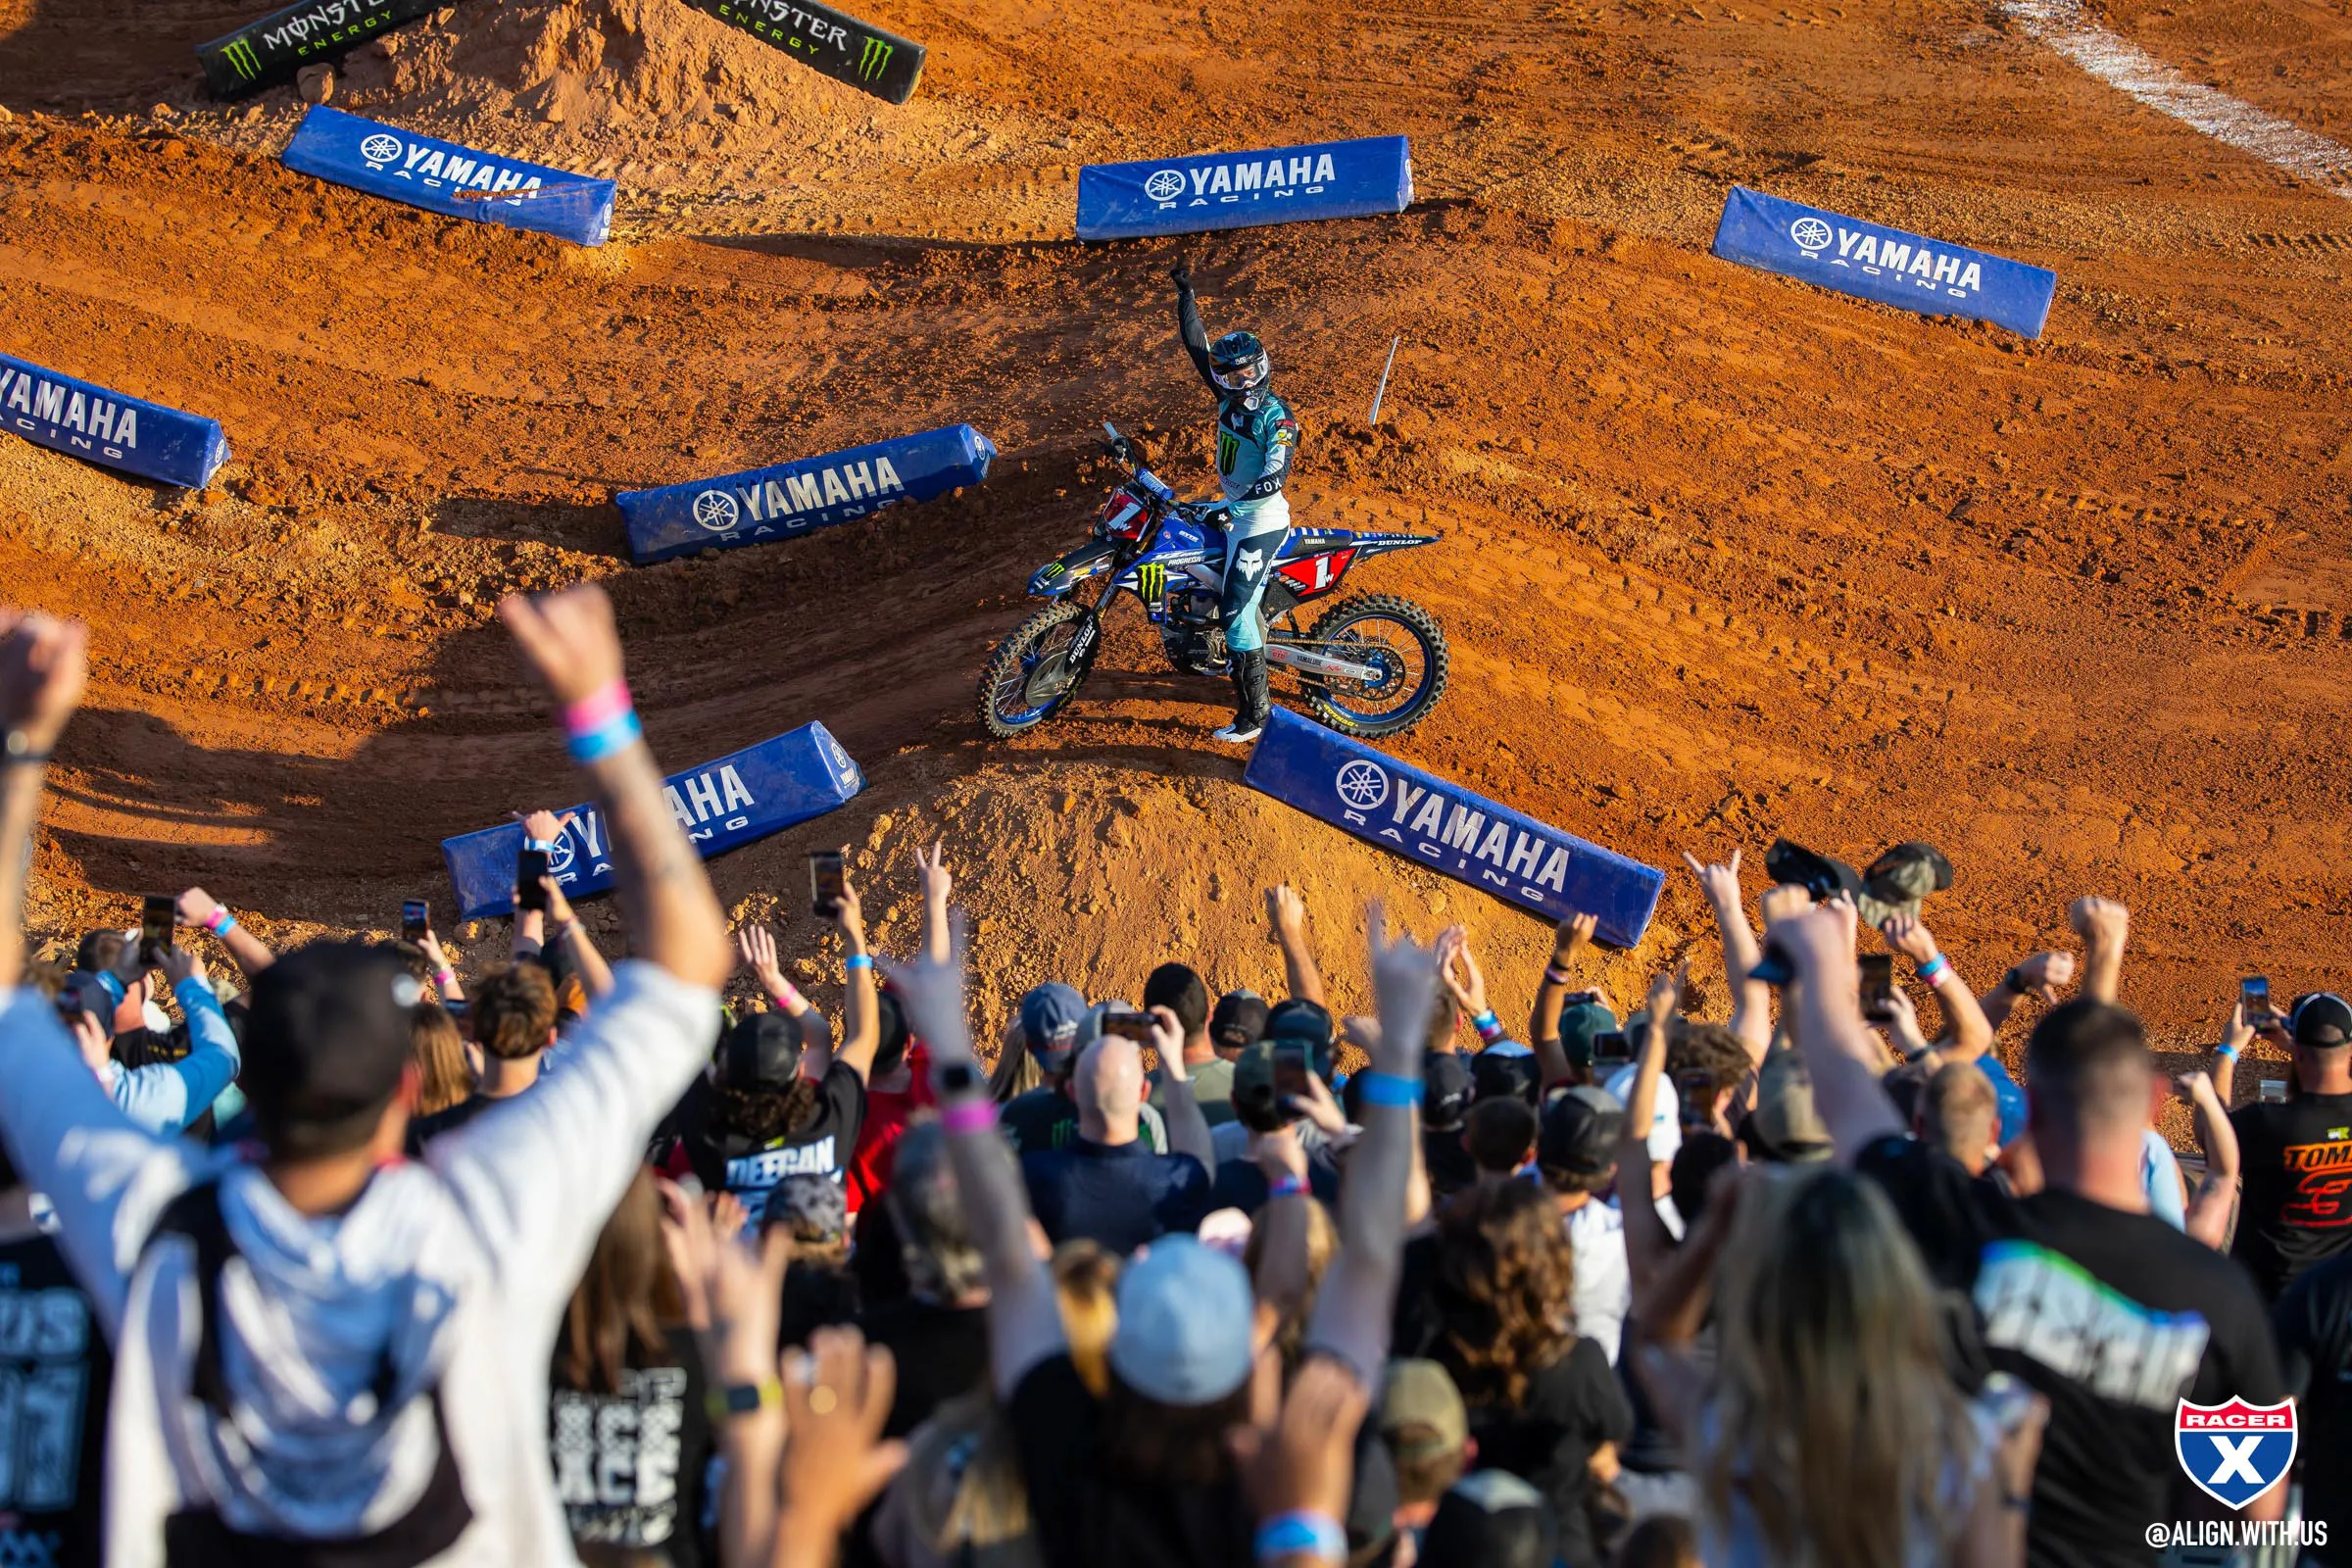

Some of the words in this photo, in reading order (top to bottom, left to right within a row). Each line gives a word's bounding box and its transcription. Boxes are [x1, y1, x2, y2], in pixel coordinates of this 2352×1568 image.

[264, 0, 386, 50] MONST
[297, 10, 391, 56] ENERGY
[718, 4, 819, 55] ENERGY
[733, 0, 848, 51] NSTER
[403, 143, 542, 199] YAMAHA
[1189, 153, 1336, 195] YAMAHA
[1158, 185, 1325, 211] RACING
[1799, 250, 1967, 299] RACING
[1838, 227, 1982, 291] YAMAHA
[0, 414, 122, 460] CING
[735, 456, 906, 521] YAMAHA
[1254, 477, 1283, 495] FOX
[1108, 502, 1142, 530] 1
[1315, 556, 1329, 590] 1
[570, 764, 755, 858] YAHA
[1392, 778, 1570, 893] YAMAHA
[556, 815, 750, 887] RANG
[1343, 808, 1544, 902] RACING
[2284, 1141, 2352, 1172] TOM
